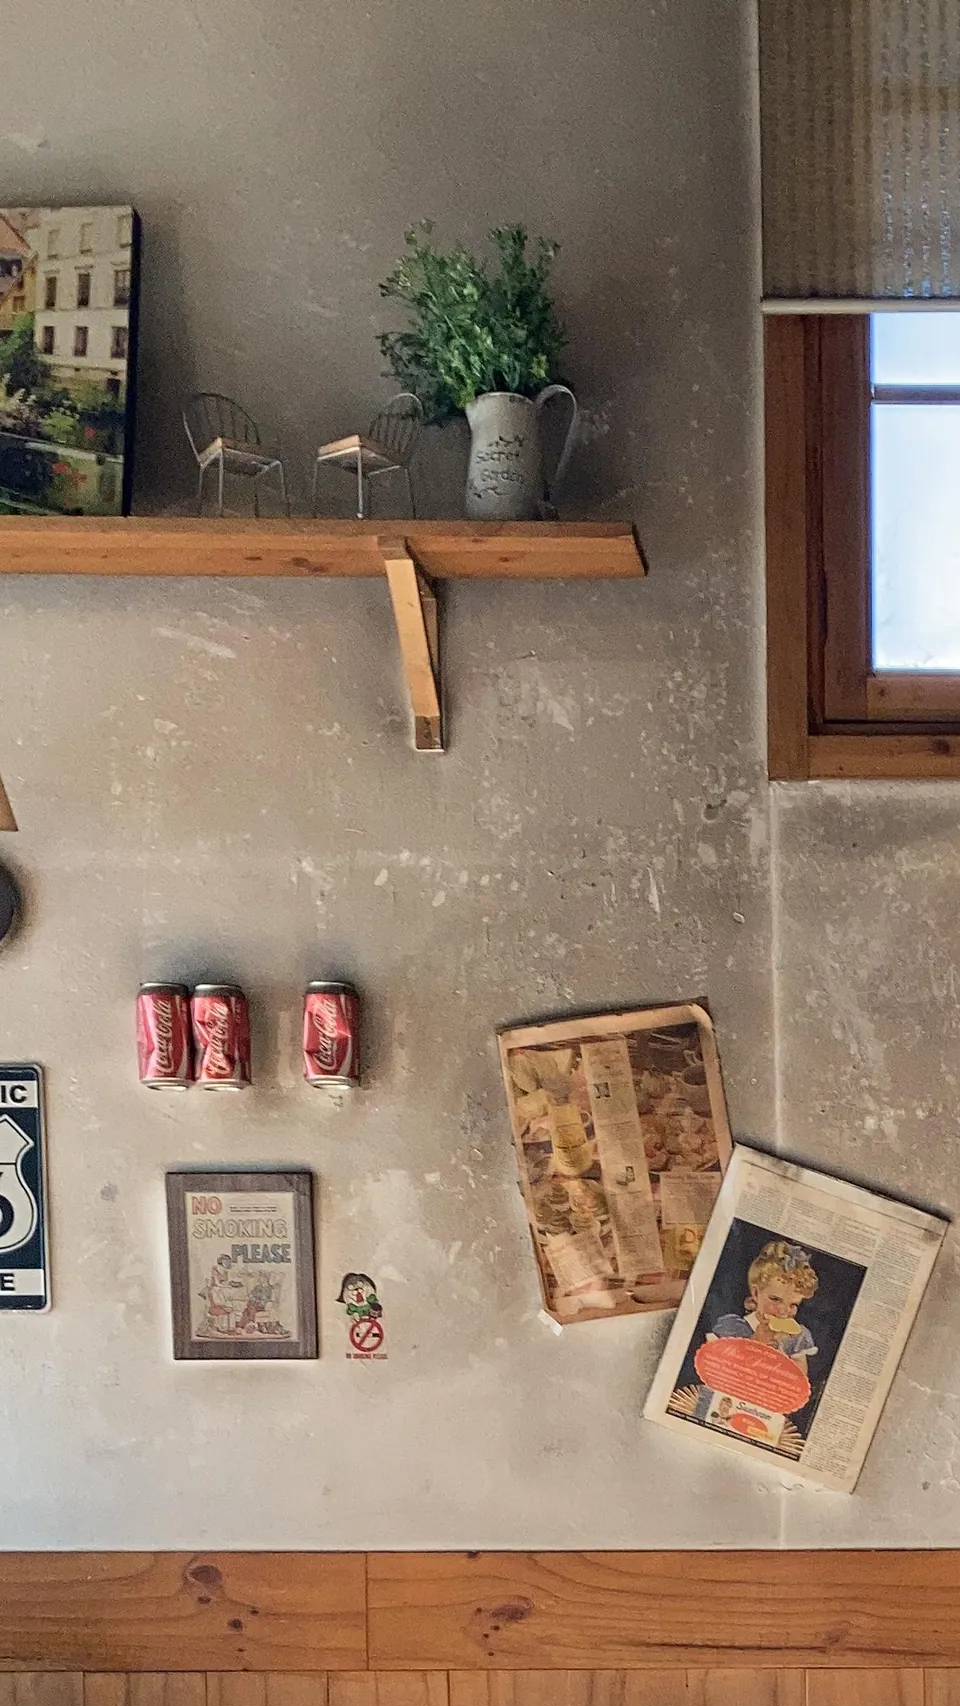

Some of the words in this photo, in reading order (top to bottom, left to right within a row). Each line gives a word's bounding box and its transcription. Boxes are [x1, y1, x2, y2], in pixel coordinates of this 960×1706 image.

[191, 1195, 222, 1215] NO
[191, 1218, 288, 1239] SMOKING
[231, 1243, 292, 1264] PLEASE
